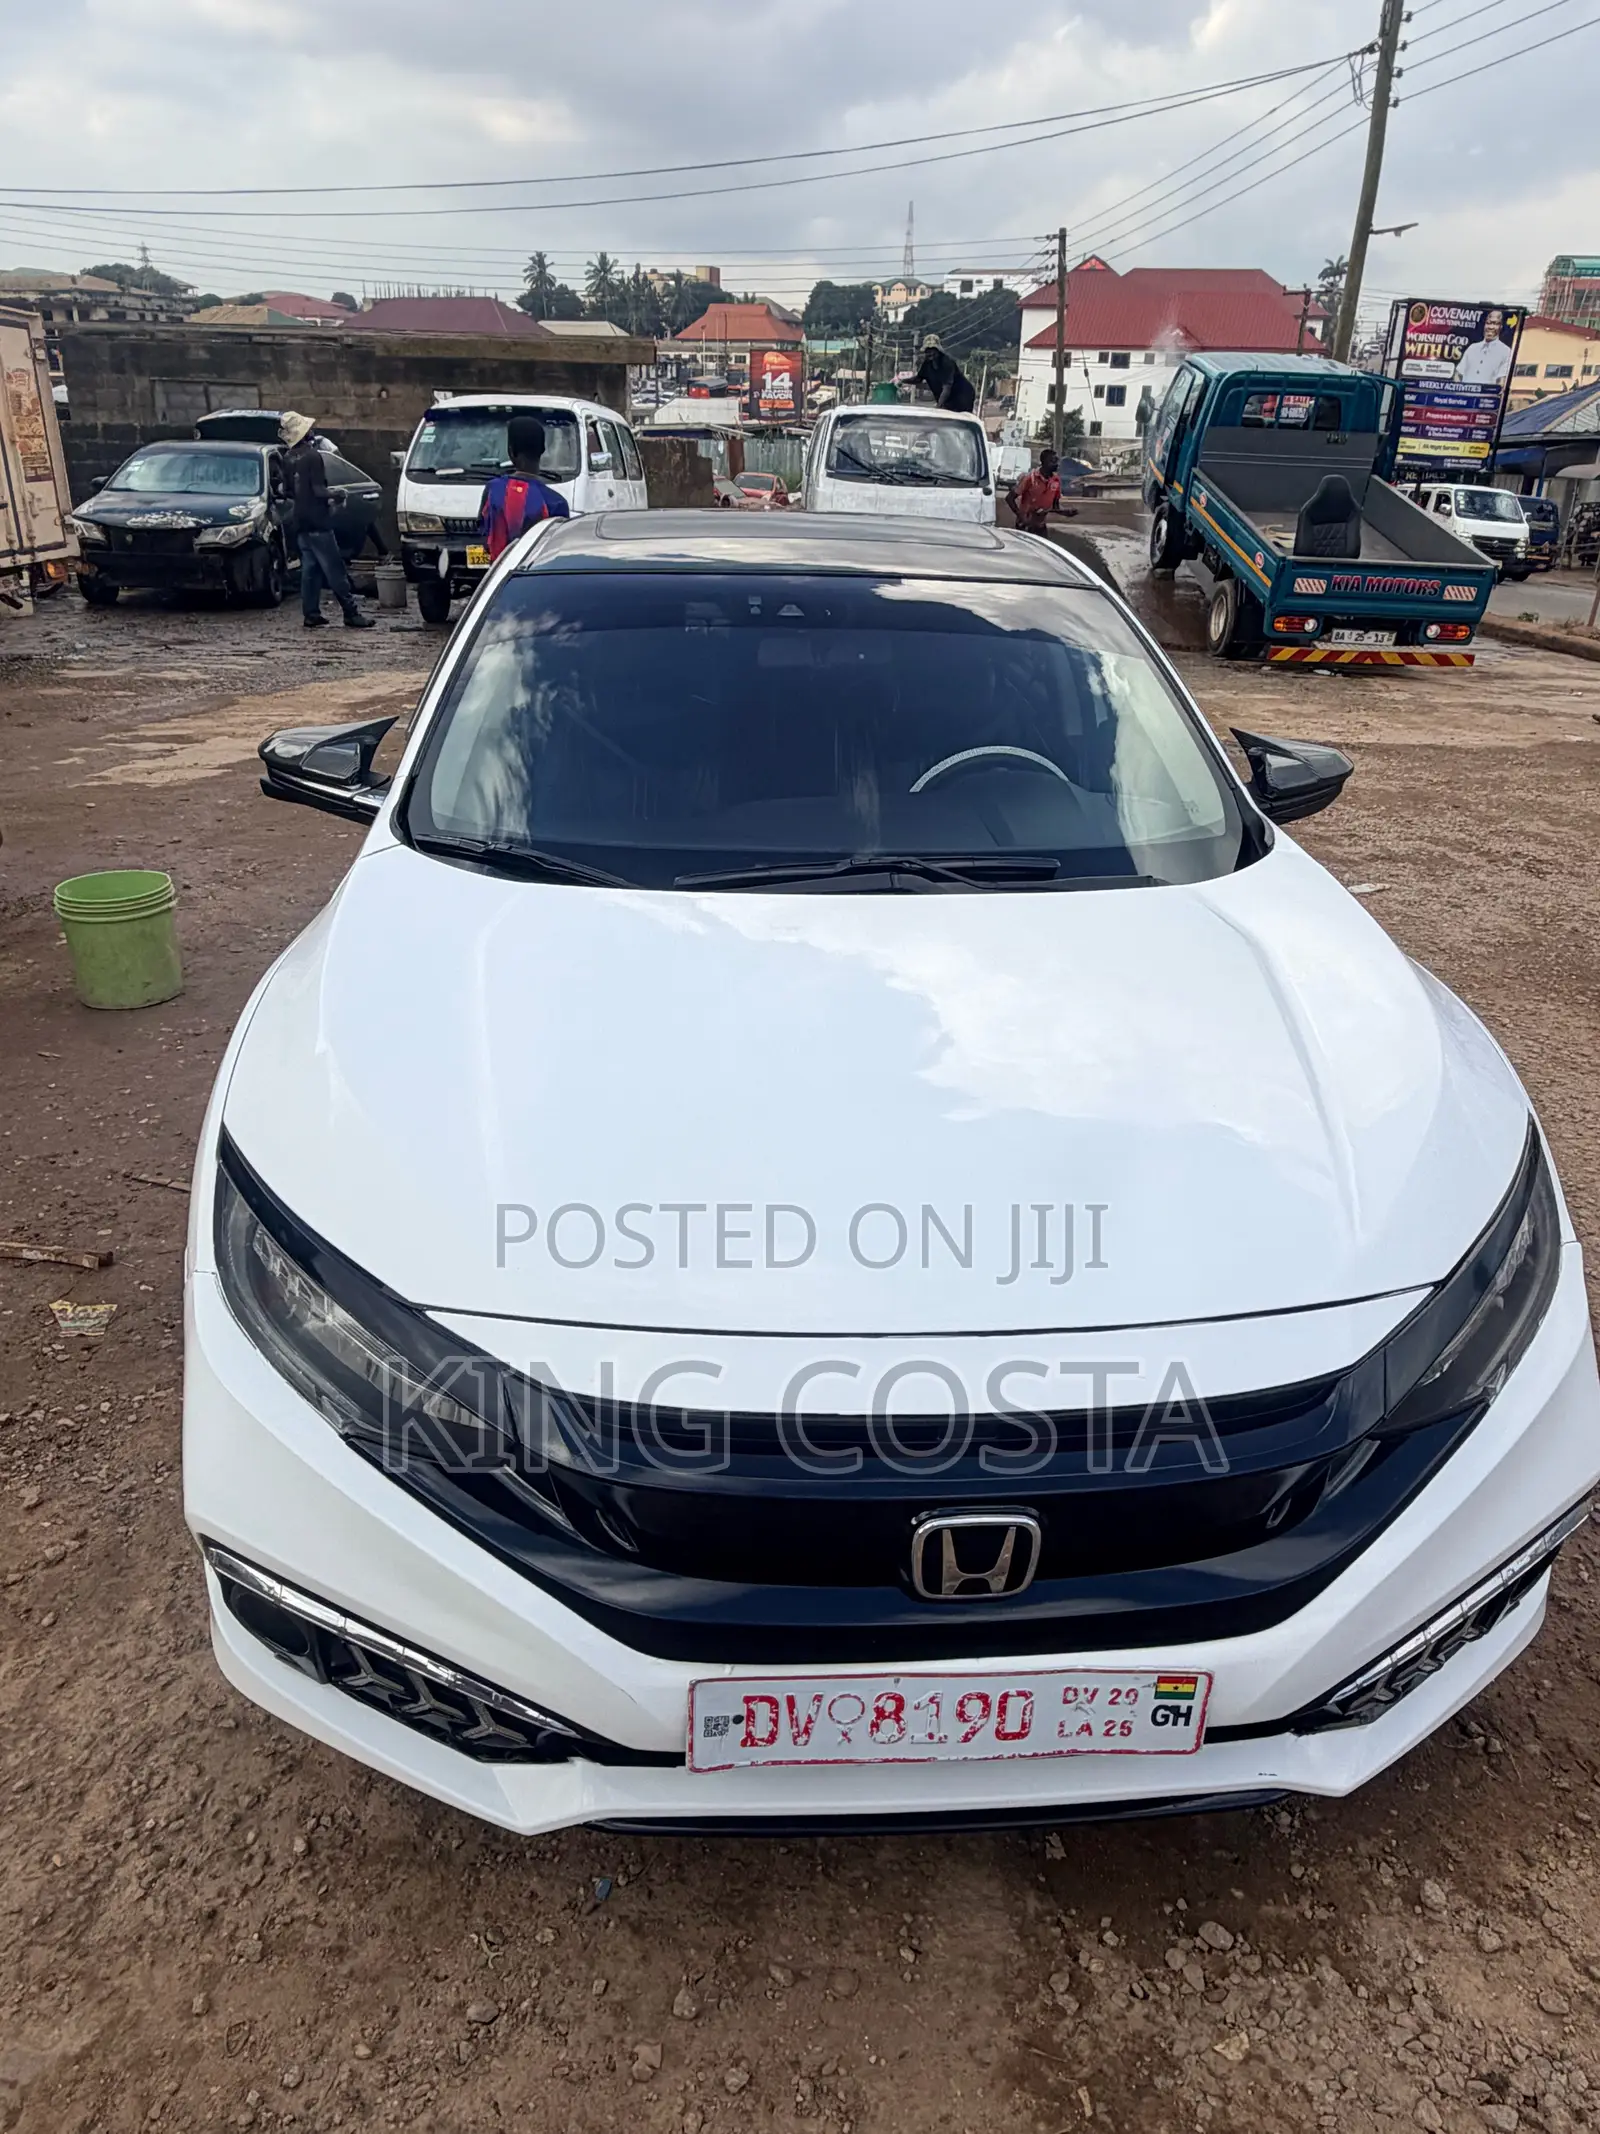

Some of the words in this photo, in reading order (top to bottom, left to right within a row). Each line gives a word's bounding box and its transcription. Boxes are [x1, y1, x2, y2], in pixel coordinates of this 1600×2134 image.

[1430, 306, 1483, 322] COVENANT
[1406, 331, 1447, 343] WORSHIP
[1447, 334, 1469, 346] GOD
[1405, 342, 1442, 357] WITH
[1443, 345, 1463, 360] US
[762, 372, 793, 391] 14
[1419, 381, 1444, 390] WEEKLY
[1331, 575, 1362, 592] KIA
[1365, 576, 1441, 597] MOTORS
[1062, 1686, 1099, 1705] DV
[740, 1692, 825, 1748] DV
[868, 1688, 1035, 1746] 8190
[1150, 1704, 1194, 1727] GH
